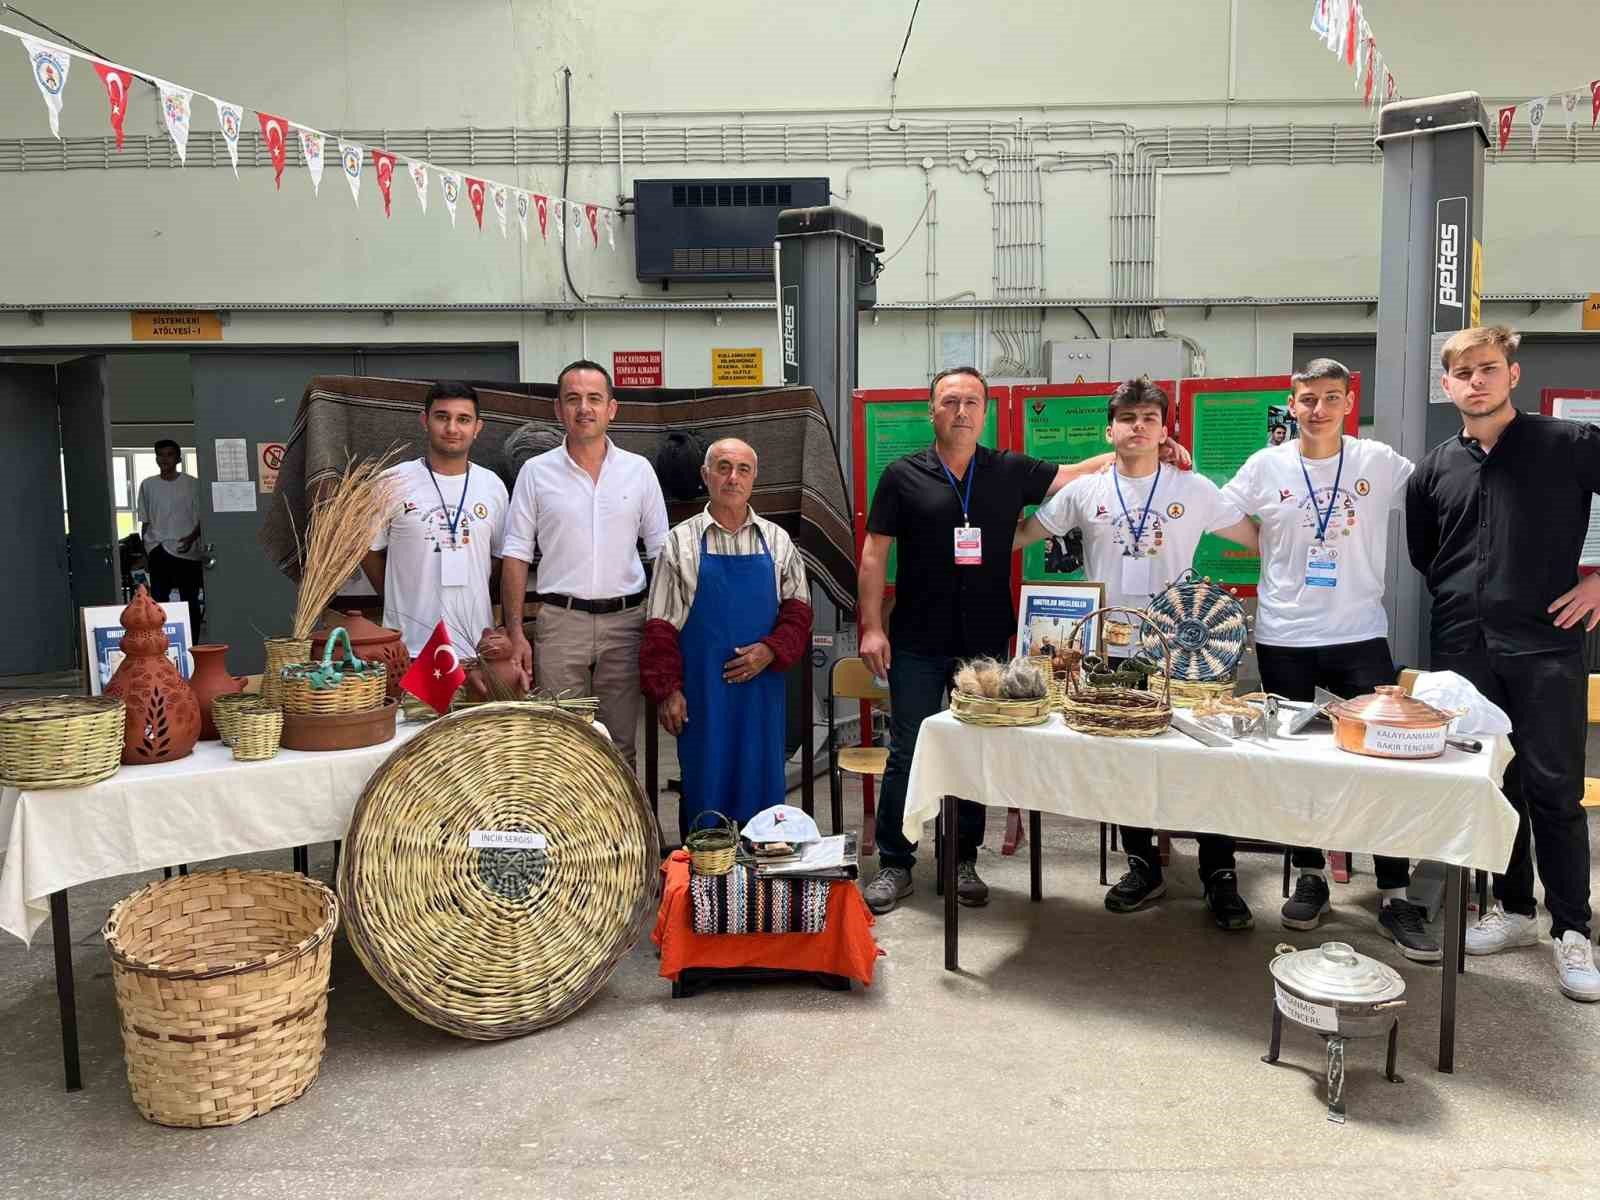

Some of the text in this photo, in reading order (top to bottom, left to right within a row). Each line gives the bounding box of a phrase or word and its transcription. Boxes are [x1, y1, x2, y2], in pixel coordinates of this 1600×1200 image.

[1439, 223, 1463, 308] petes
[784, 304, 799, 367] petes
[1376, 741, 1401, 752] BAKIR
